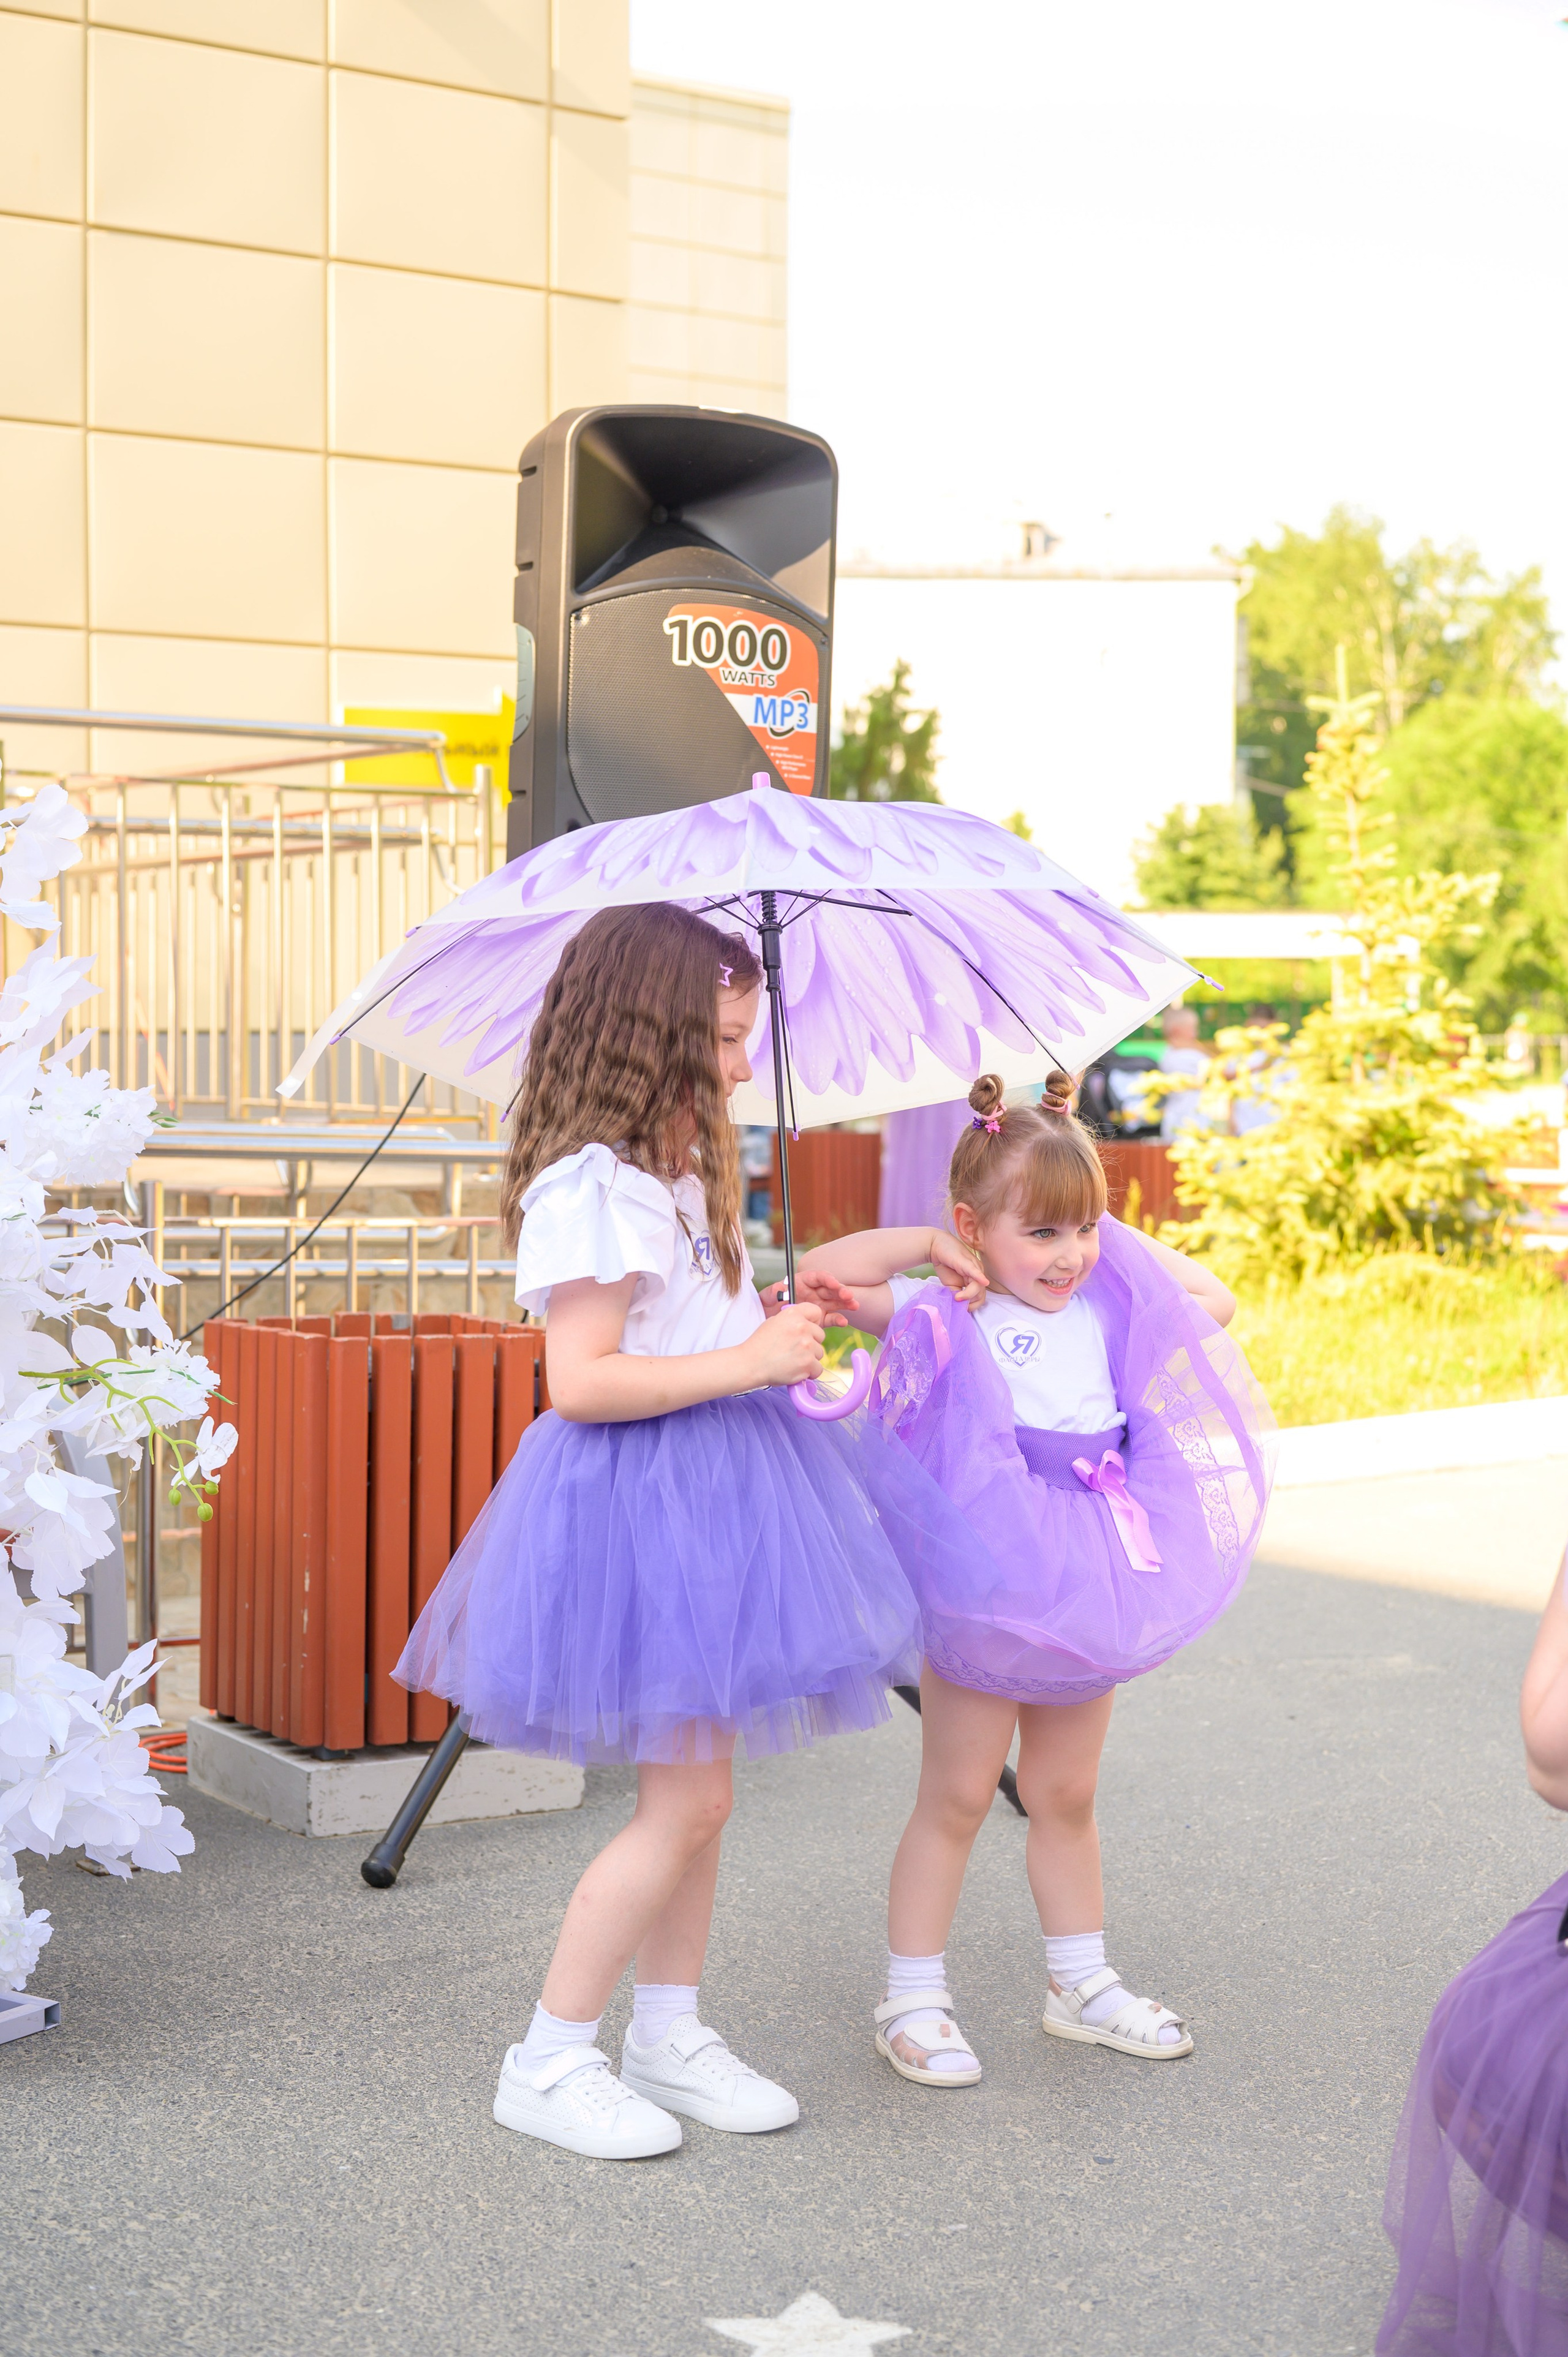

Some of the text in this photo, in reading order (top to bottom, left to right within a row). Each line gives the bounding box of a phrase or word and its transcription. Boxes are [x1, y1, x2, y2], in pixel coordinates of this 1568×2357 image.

[668, 618, 788, 671] 1000
[722, 669, 775, 687] WATTS
[753, 696, 809, 730] MP3
[1009, 1333, 1035, 1355] Я
